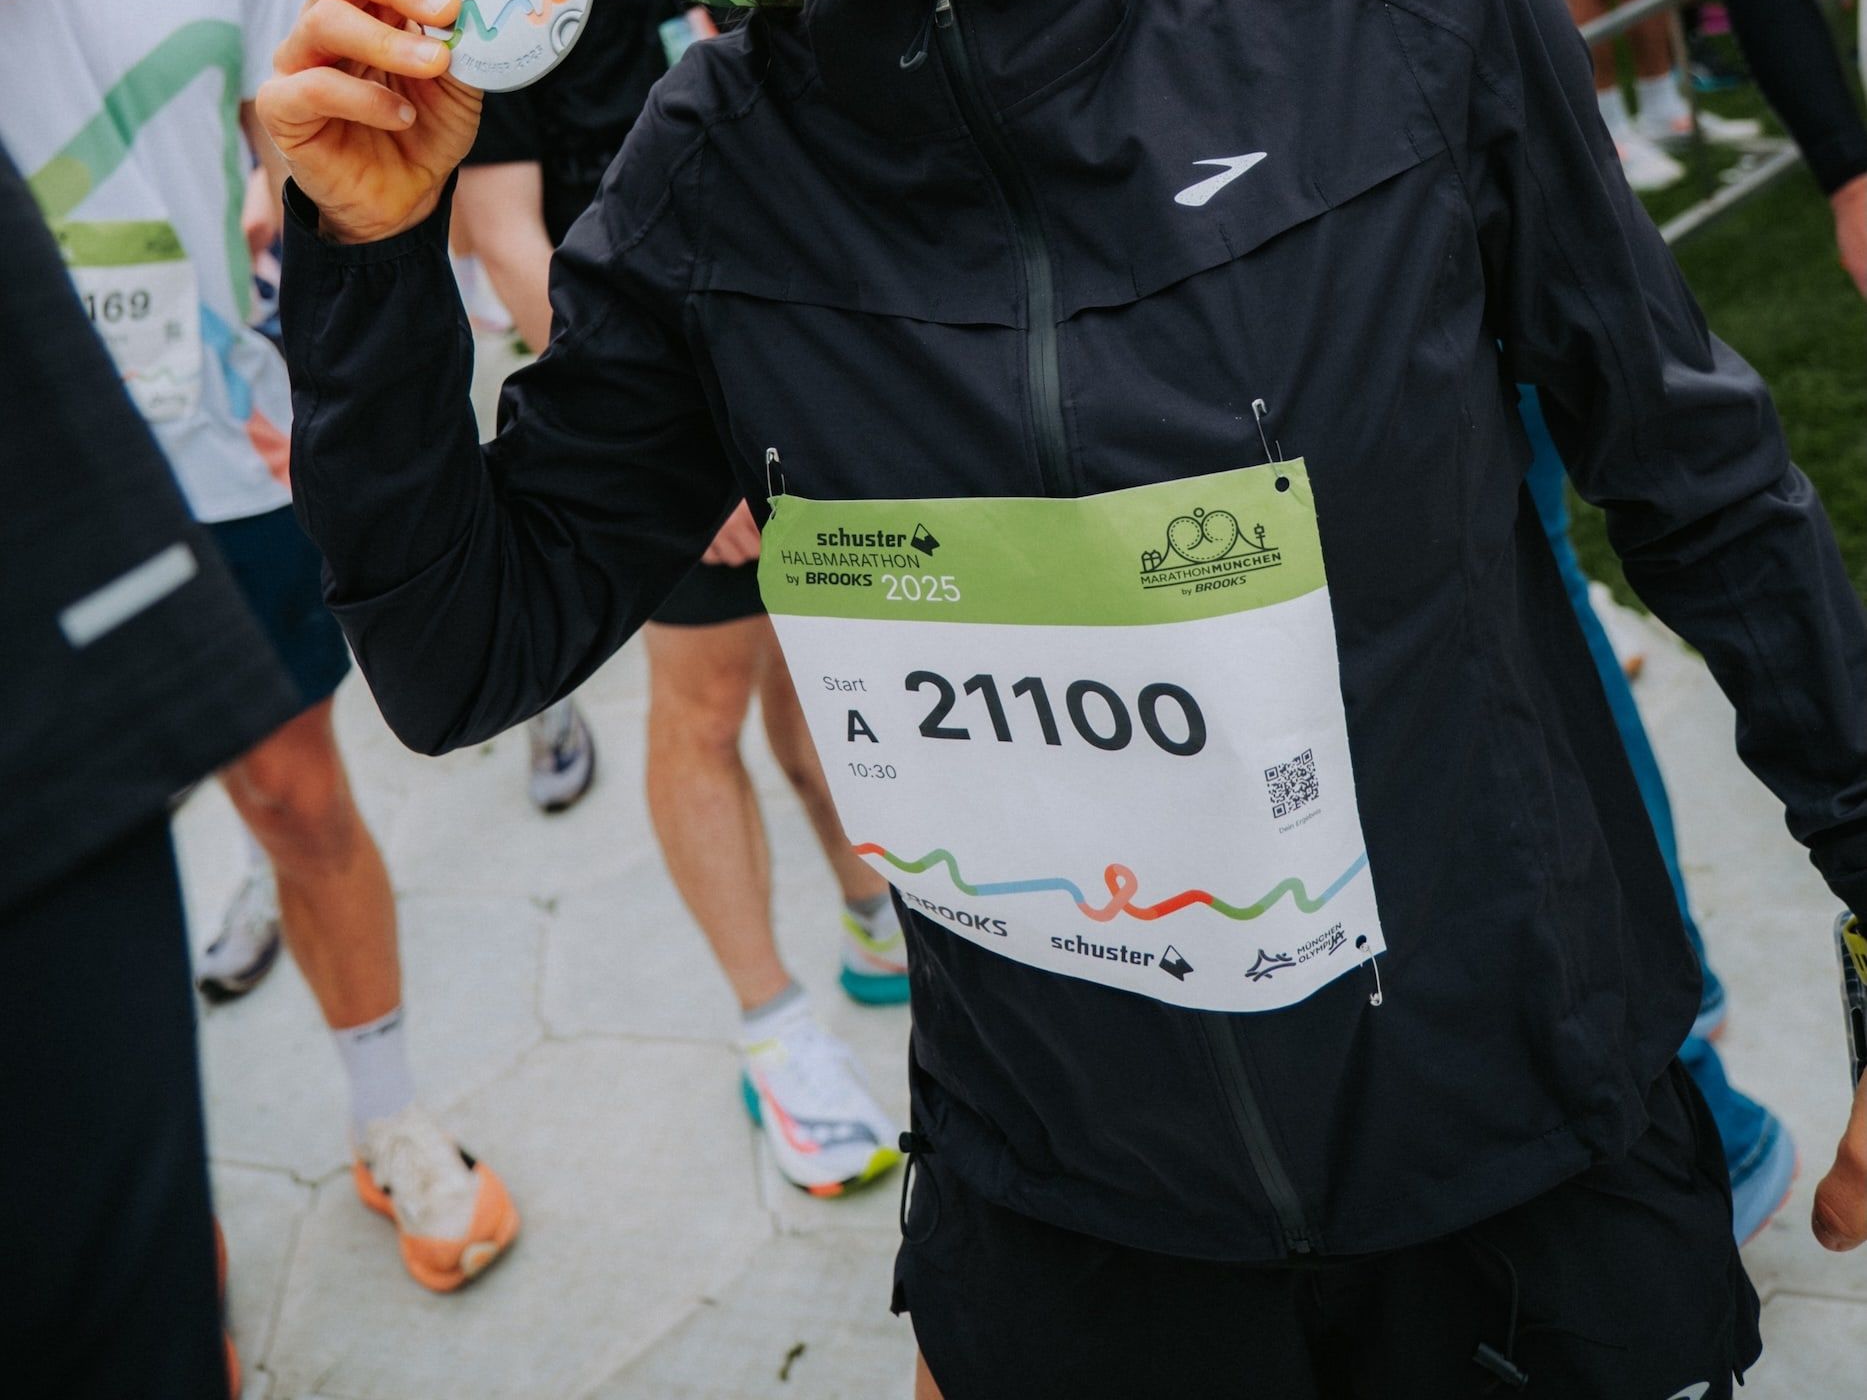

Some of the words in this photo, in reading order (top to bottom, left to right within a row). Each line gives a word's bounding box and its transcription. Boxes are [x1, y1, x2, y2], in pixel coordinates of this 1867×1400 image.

[816, 528, 907, 548] schuster
[781, 550, 920, 569] HALBMARATHON
[786, 573, 800, 586] by
[805, 572, 873, 587] BROOKS
[881, 574, 961, 601] 2025
[1181, 588, 1192, 596] by
[1195, 575, 1247, 593] BROOKS
[822, 676, 867, 693] Start
[905, 670, 1208, 756] 21100
[847, 709, 880, 743] A
[848, 762, 897, 780] 10:30
[1297, 922, 1342, 955] MÜNCHEN
[1050, 935, 1155, 967] schuster
